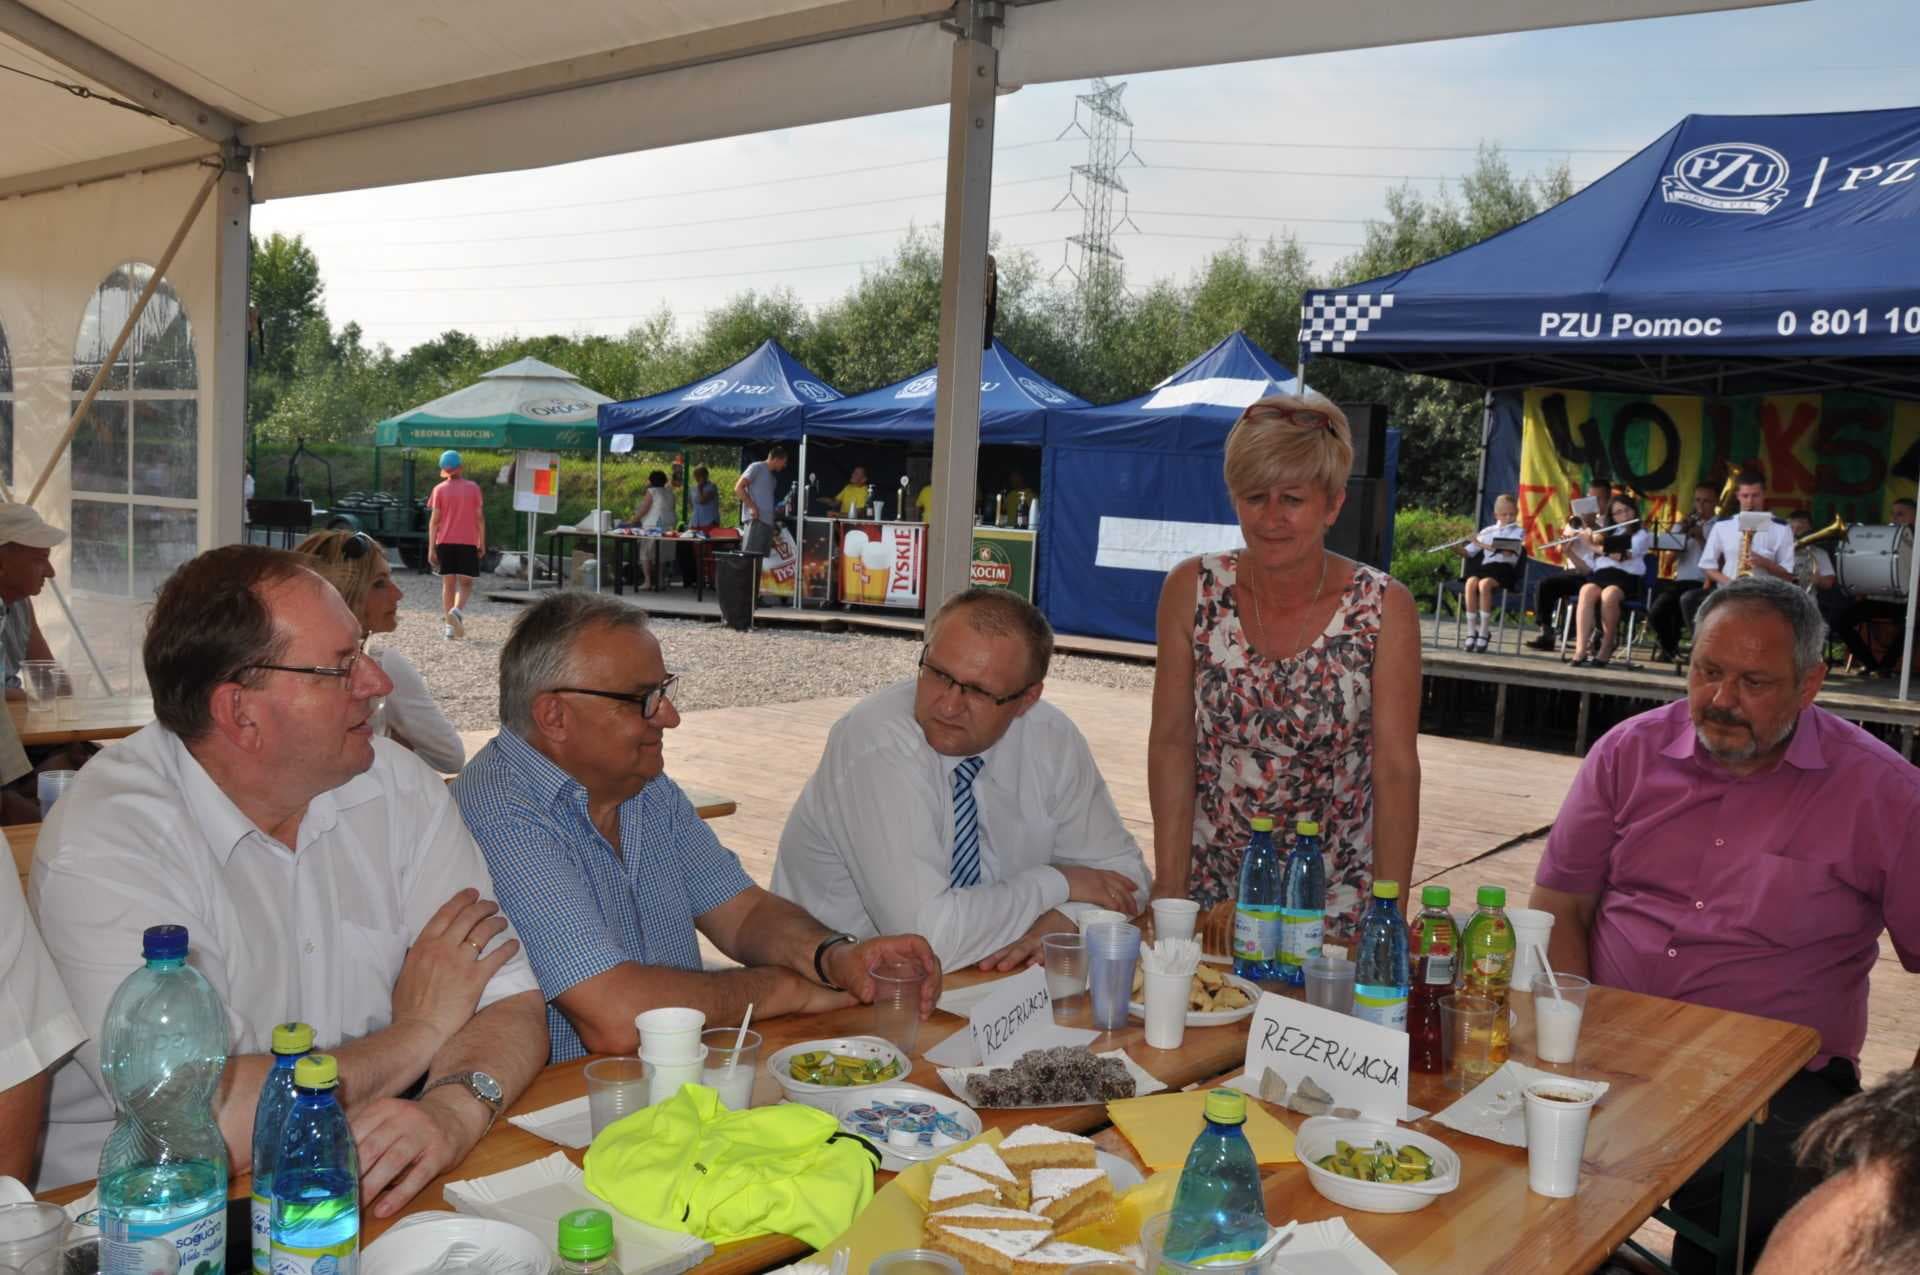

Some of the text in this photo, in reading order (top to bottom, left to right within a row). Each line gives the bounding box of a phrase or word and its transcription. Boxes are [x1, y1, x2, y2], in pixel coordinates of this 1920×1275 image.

[1687, 151, 1776, 193] PZU
[1838, 157, 1920, 192] PZ
[1540, 305, 1920, 338] PZU Pomoc 0 801 10
[773, 563, 796, 582] TYS
[891, 527, 912, 593] TYSKIE
[970, 565, 1006, 580] KOCIM
[1260, 1017, 1400, 1087] REZERWACJA
